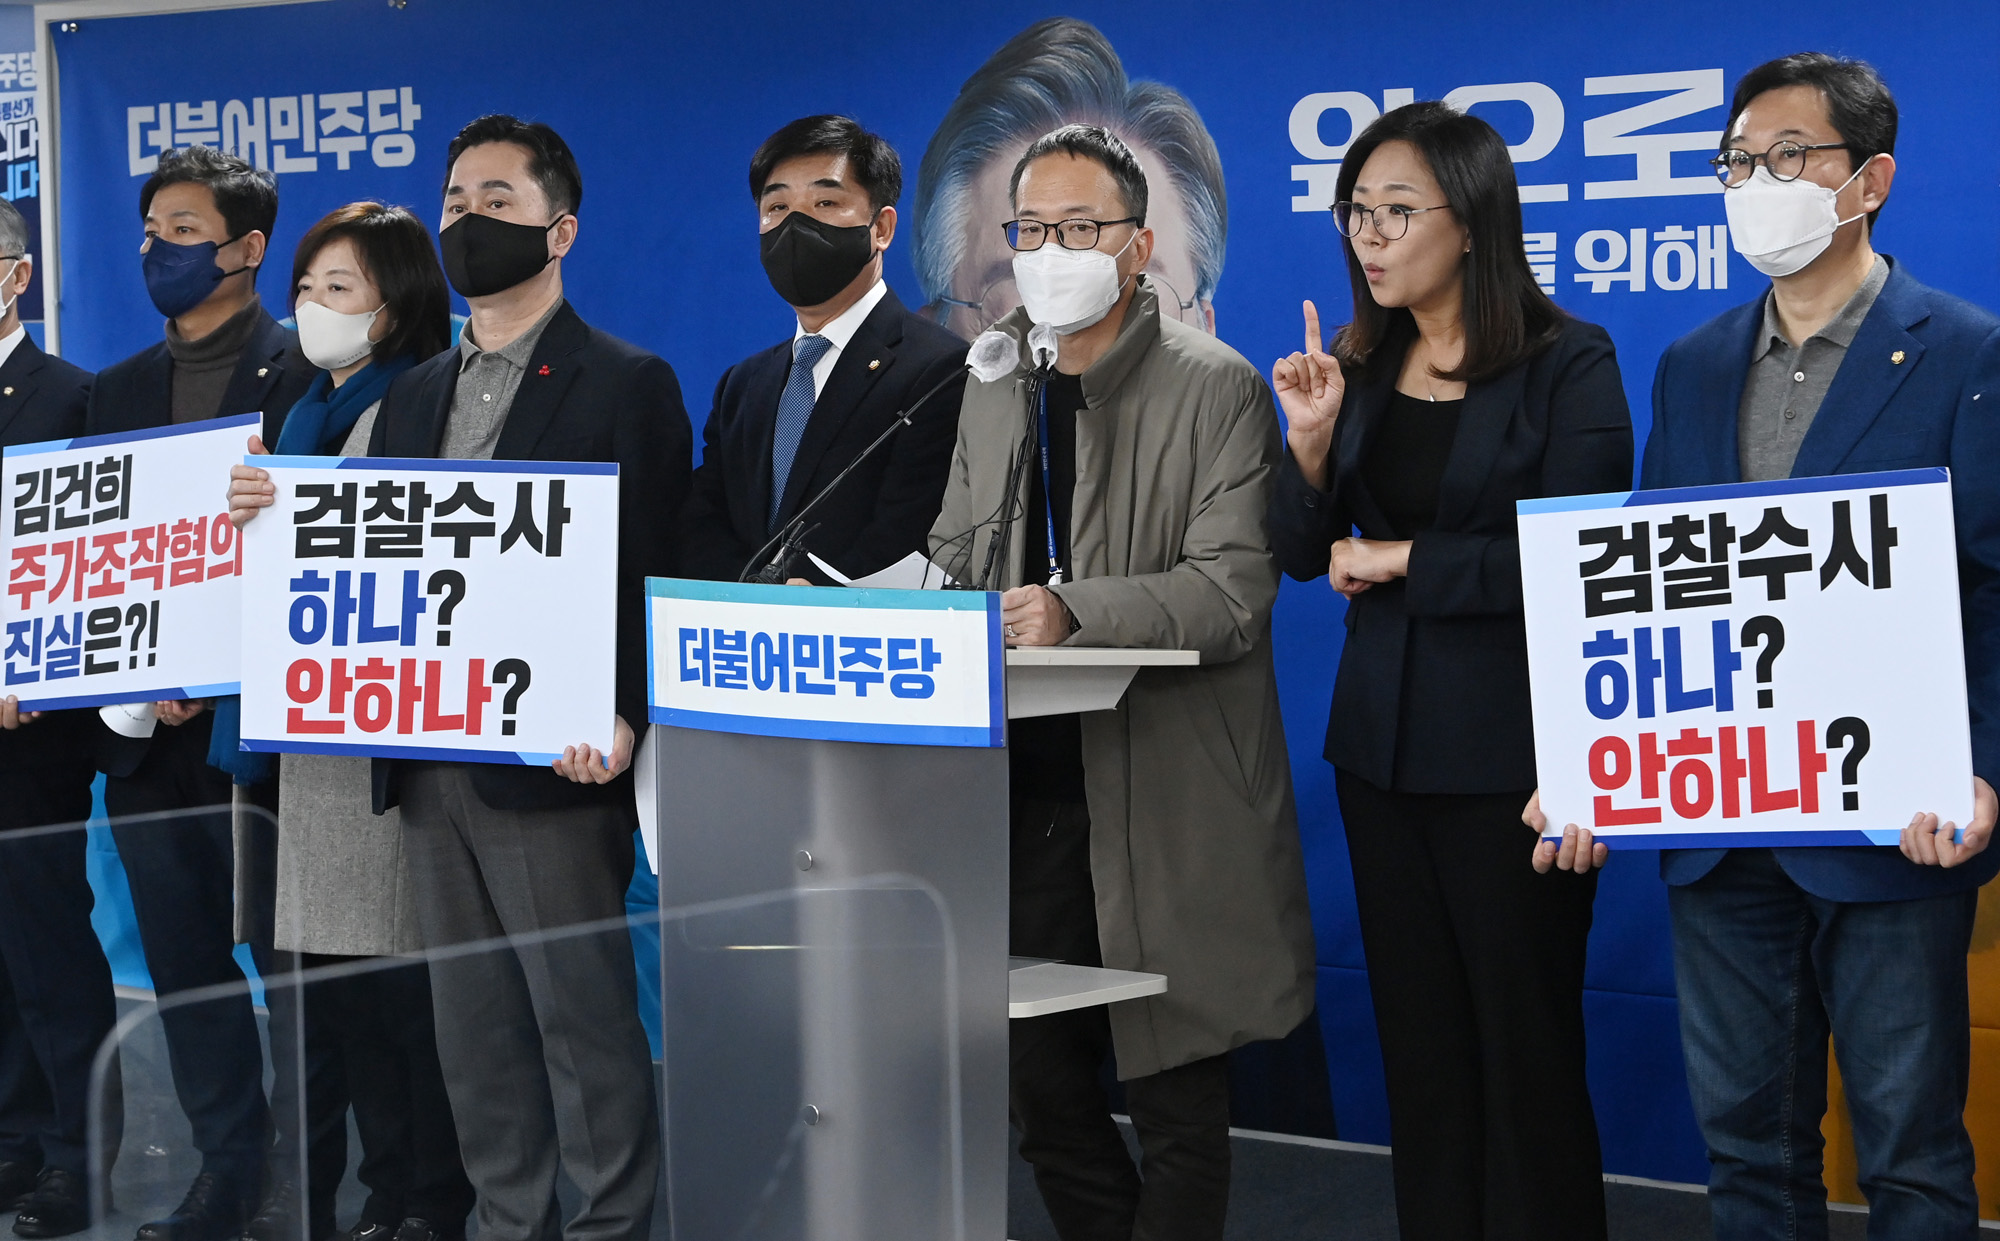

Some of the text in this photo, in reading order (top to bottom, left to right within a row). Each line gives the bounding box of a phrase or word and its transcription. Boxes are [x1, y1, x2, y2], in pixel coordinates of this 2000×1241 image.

[127, 87, 422, 176] 더불어민주당
[1574, 225, 1728, 293] 위해
[14, 454, 133, 537] 김건희
[293, 479, 571, 559] 검찰수사
[8, 512, 243, 610] 주가조작혐의
[1578, 493, 1898, 618] 검찰수사
[4, 600, 160, 686] 진실은?!
[288, 569, 466, 646] 하나?
[285, 657, 532, 736] 안하나?
[679, 627, 942, 699] 더불어민주당
[1582, 615, 1785, 720] 하나?
[1588, 716, 1870, 827] 안하나?
